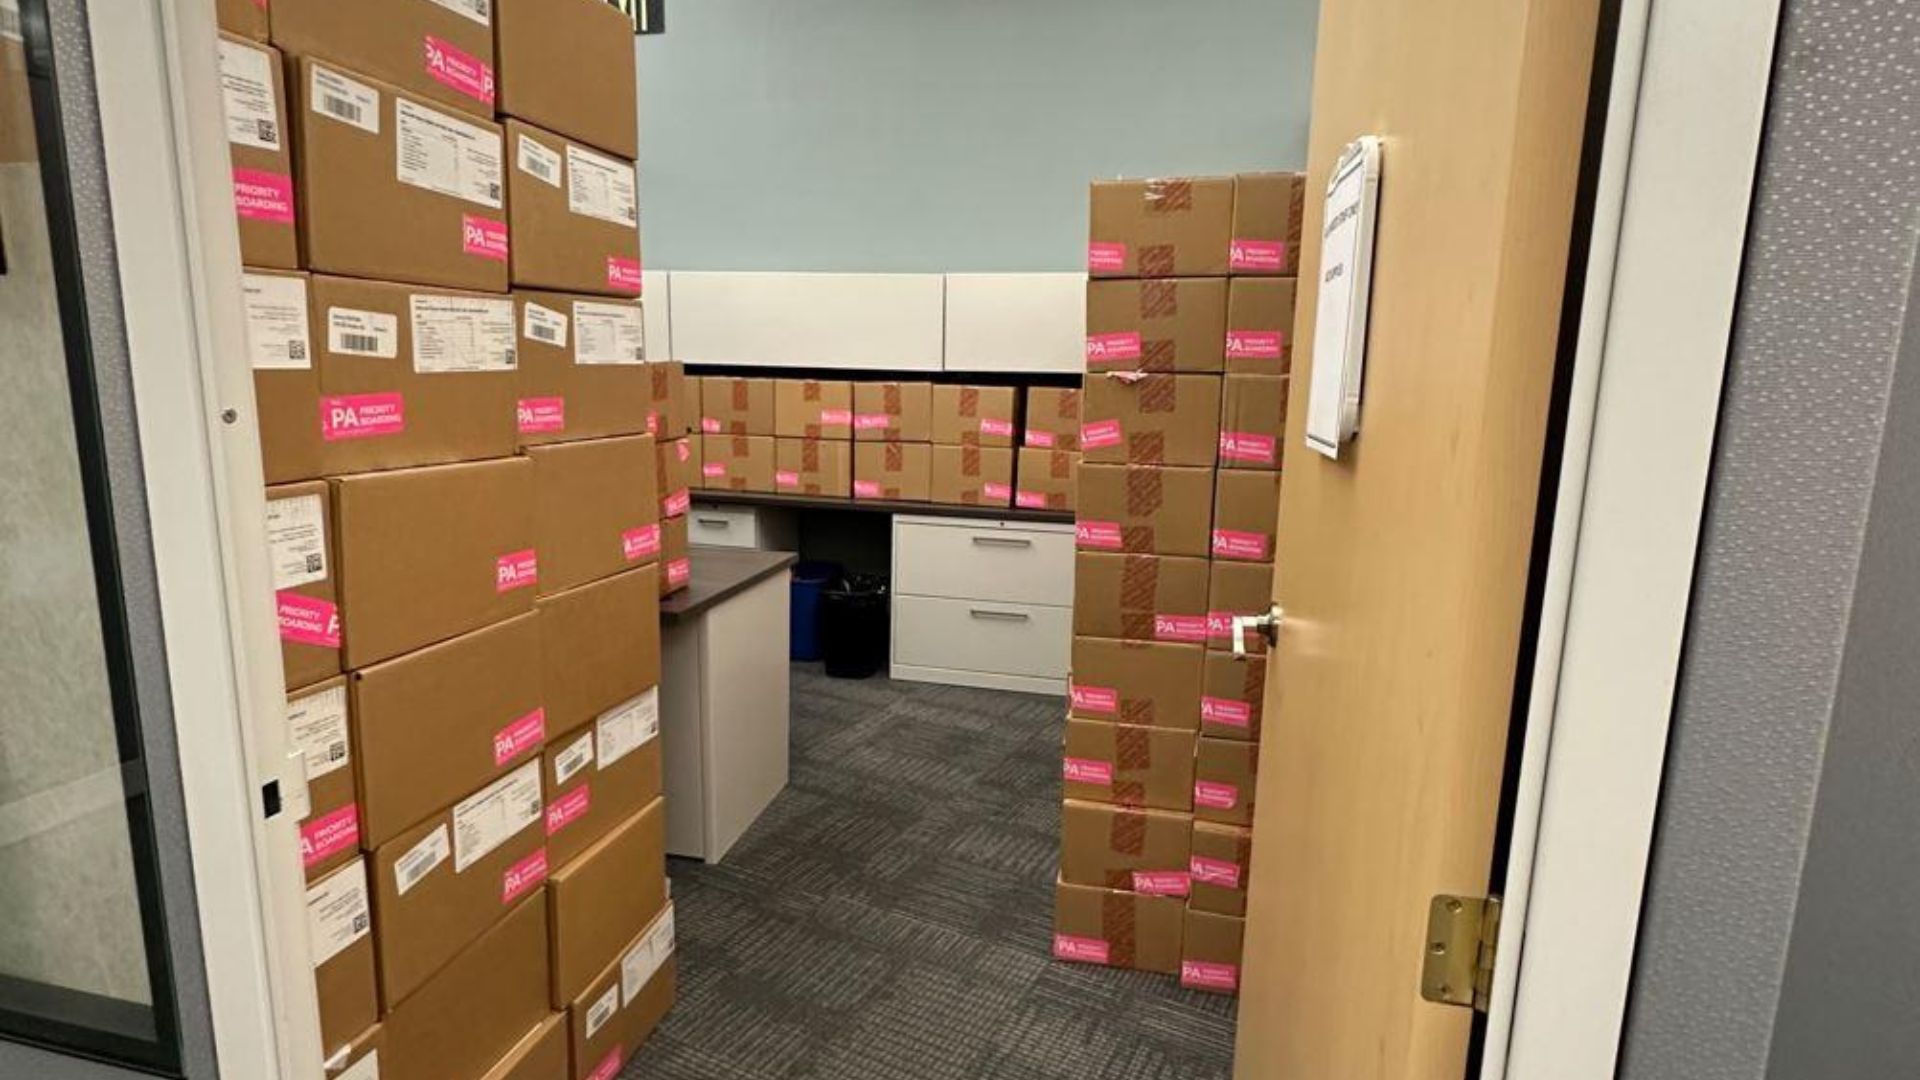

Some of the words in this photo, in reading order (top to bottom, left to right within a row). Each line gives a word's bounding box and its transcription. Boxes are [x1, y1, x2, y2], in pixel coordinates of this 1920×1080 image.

[235, 183, 280, 200] PRIORITY
[466, 225, 486, 248] PA
[1087, 341, 1106, 356] PA
[331, 407, 360, 429] PA
[359, 404, 396, 416] PRIORITY
[498, 563, 518, 583] PA
[279, 605, 321, 621] PRIORITY
[1156, 620, 1176, 633] PA
[495, 736, 514, 757] PA
[314, 815, 353, 841] PRIORITY
[1135, 876, 1153, 889] PA
